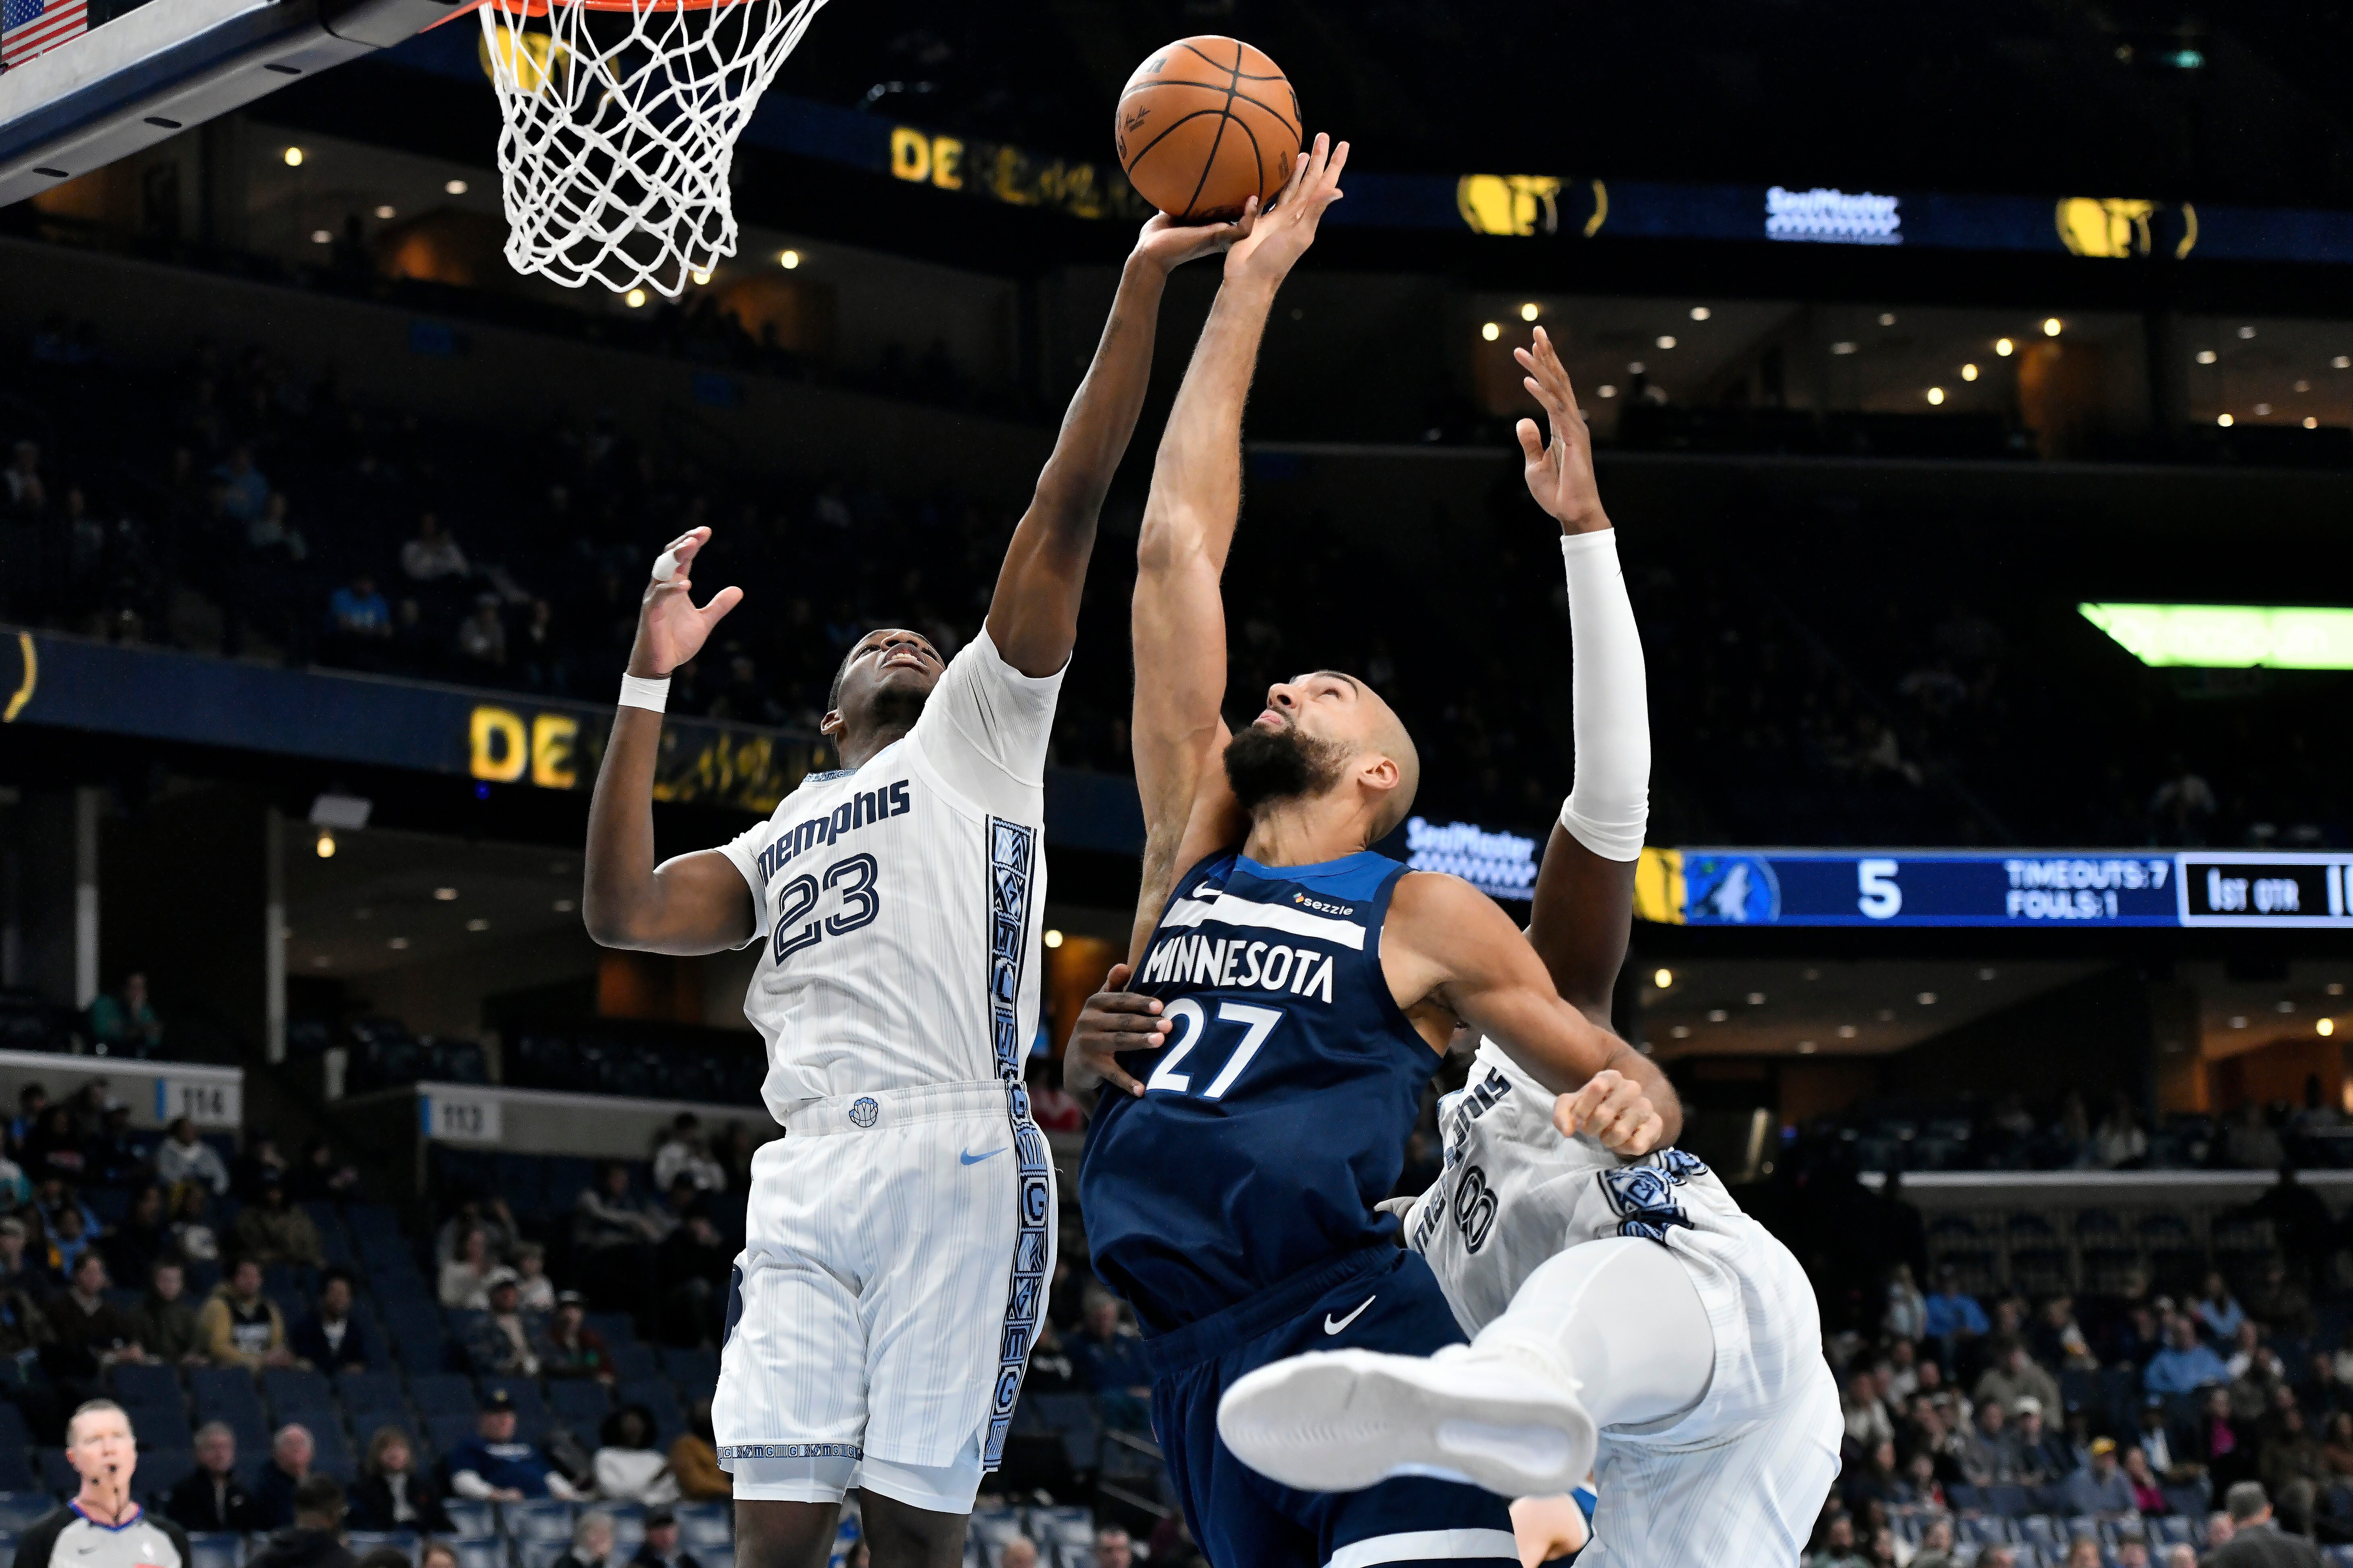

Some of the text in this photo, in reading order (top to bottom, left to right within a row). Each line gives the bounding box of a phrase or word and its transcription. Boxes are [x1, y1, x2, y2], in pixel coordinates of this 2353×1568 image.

[773, 852, 879, 968] 23
[1303, 897, 1354, 915] sezzle
[1857, 859, 1903, 919] 5
[1142, 935, 1333, 1004] MINNESOTA
[1146, 998, 1284, 1099] 27
[1454, 1165, 1498, 1254] 8
